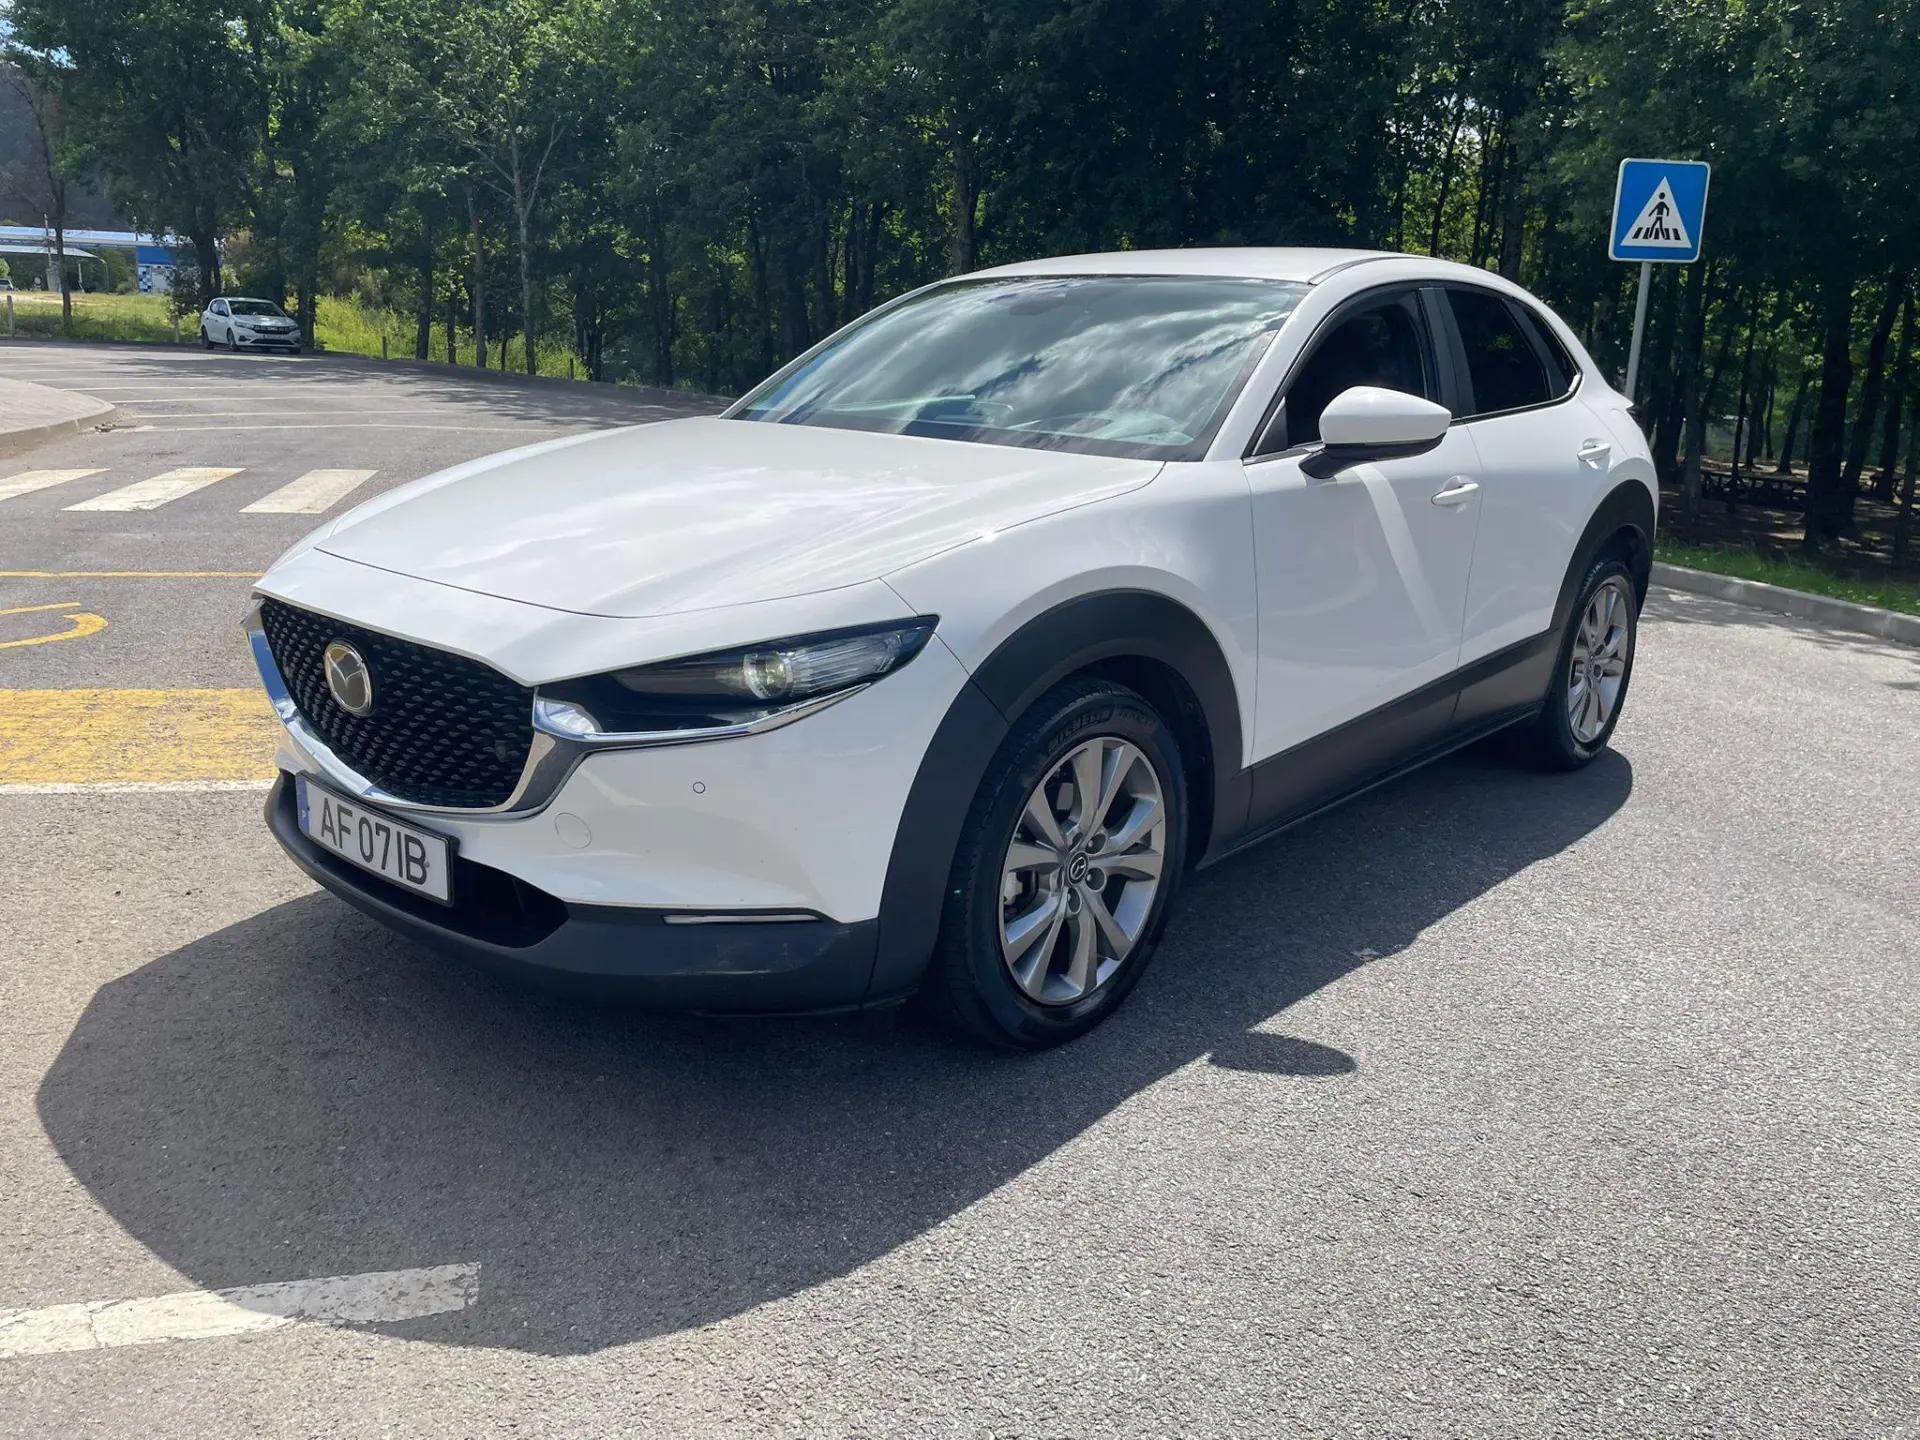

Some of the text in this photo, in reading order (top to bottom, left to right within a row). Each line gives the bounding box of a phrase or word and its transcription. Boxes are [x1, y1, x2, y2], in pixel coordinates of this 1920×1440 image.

[321, 797, 427, 886] AF 07 IB
